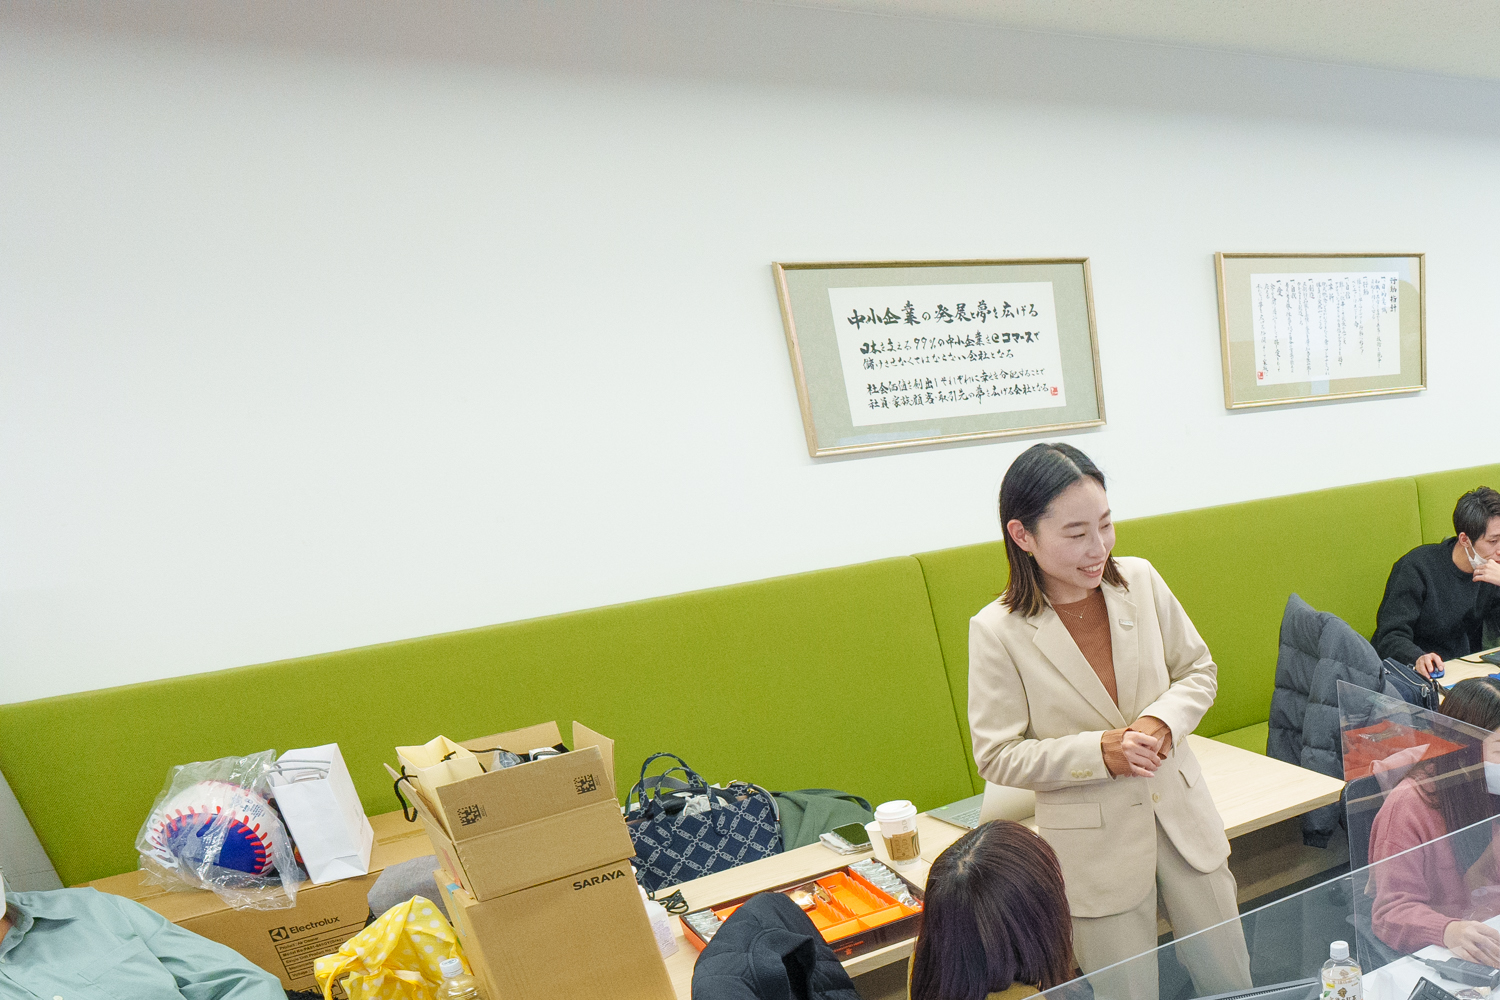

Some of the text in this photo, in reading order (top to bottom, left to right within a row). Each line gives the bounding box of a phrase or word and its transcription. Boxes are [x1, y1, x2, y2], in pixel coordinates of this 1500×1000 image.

[846, 299, 1039, 330] 中小企業の発展と夢を広げる
[572, 869, 626, 891] SARAYA
[289, 916, 341, 935] Electrolux
